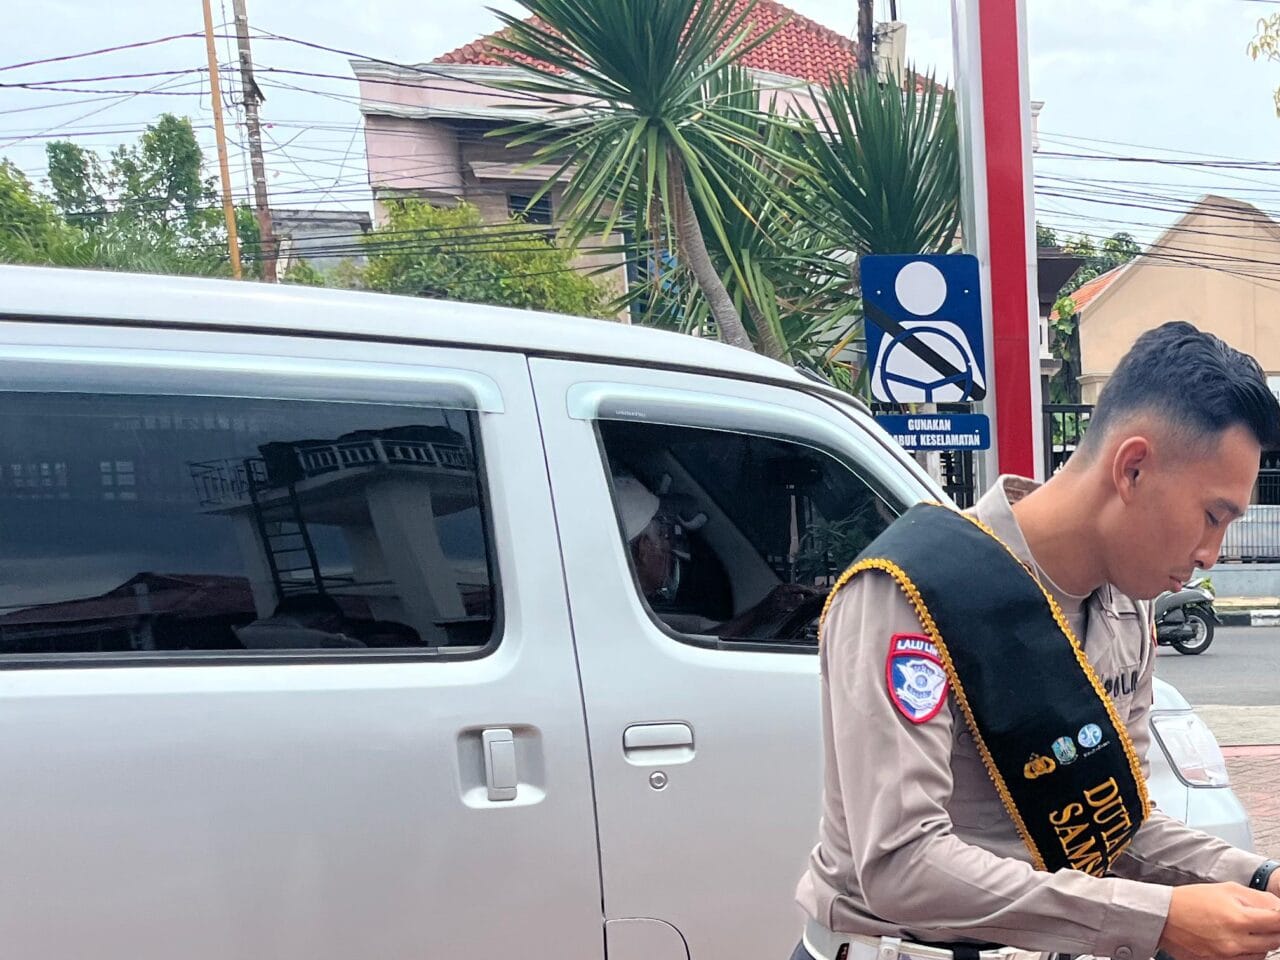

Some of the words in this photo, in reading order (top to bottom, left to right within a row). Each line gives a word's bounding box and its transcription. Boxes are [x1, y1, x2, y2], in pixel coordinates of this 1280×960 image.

[907, 419, 952, 431] GUNAKAN
[894, 434, 917, 446] ABUK
[920, 434, 981, 446] KESELAMATAN
[896, 639, 923, 650] LALU
